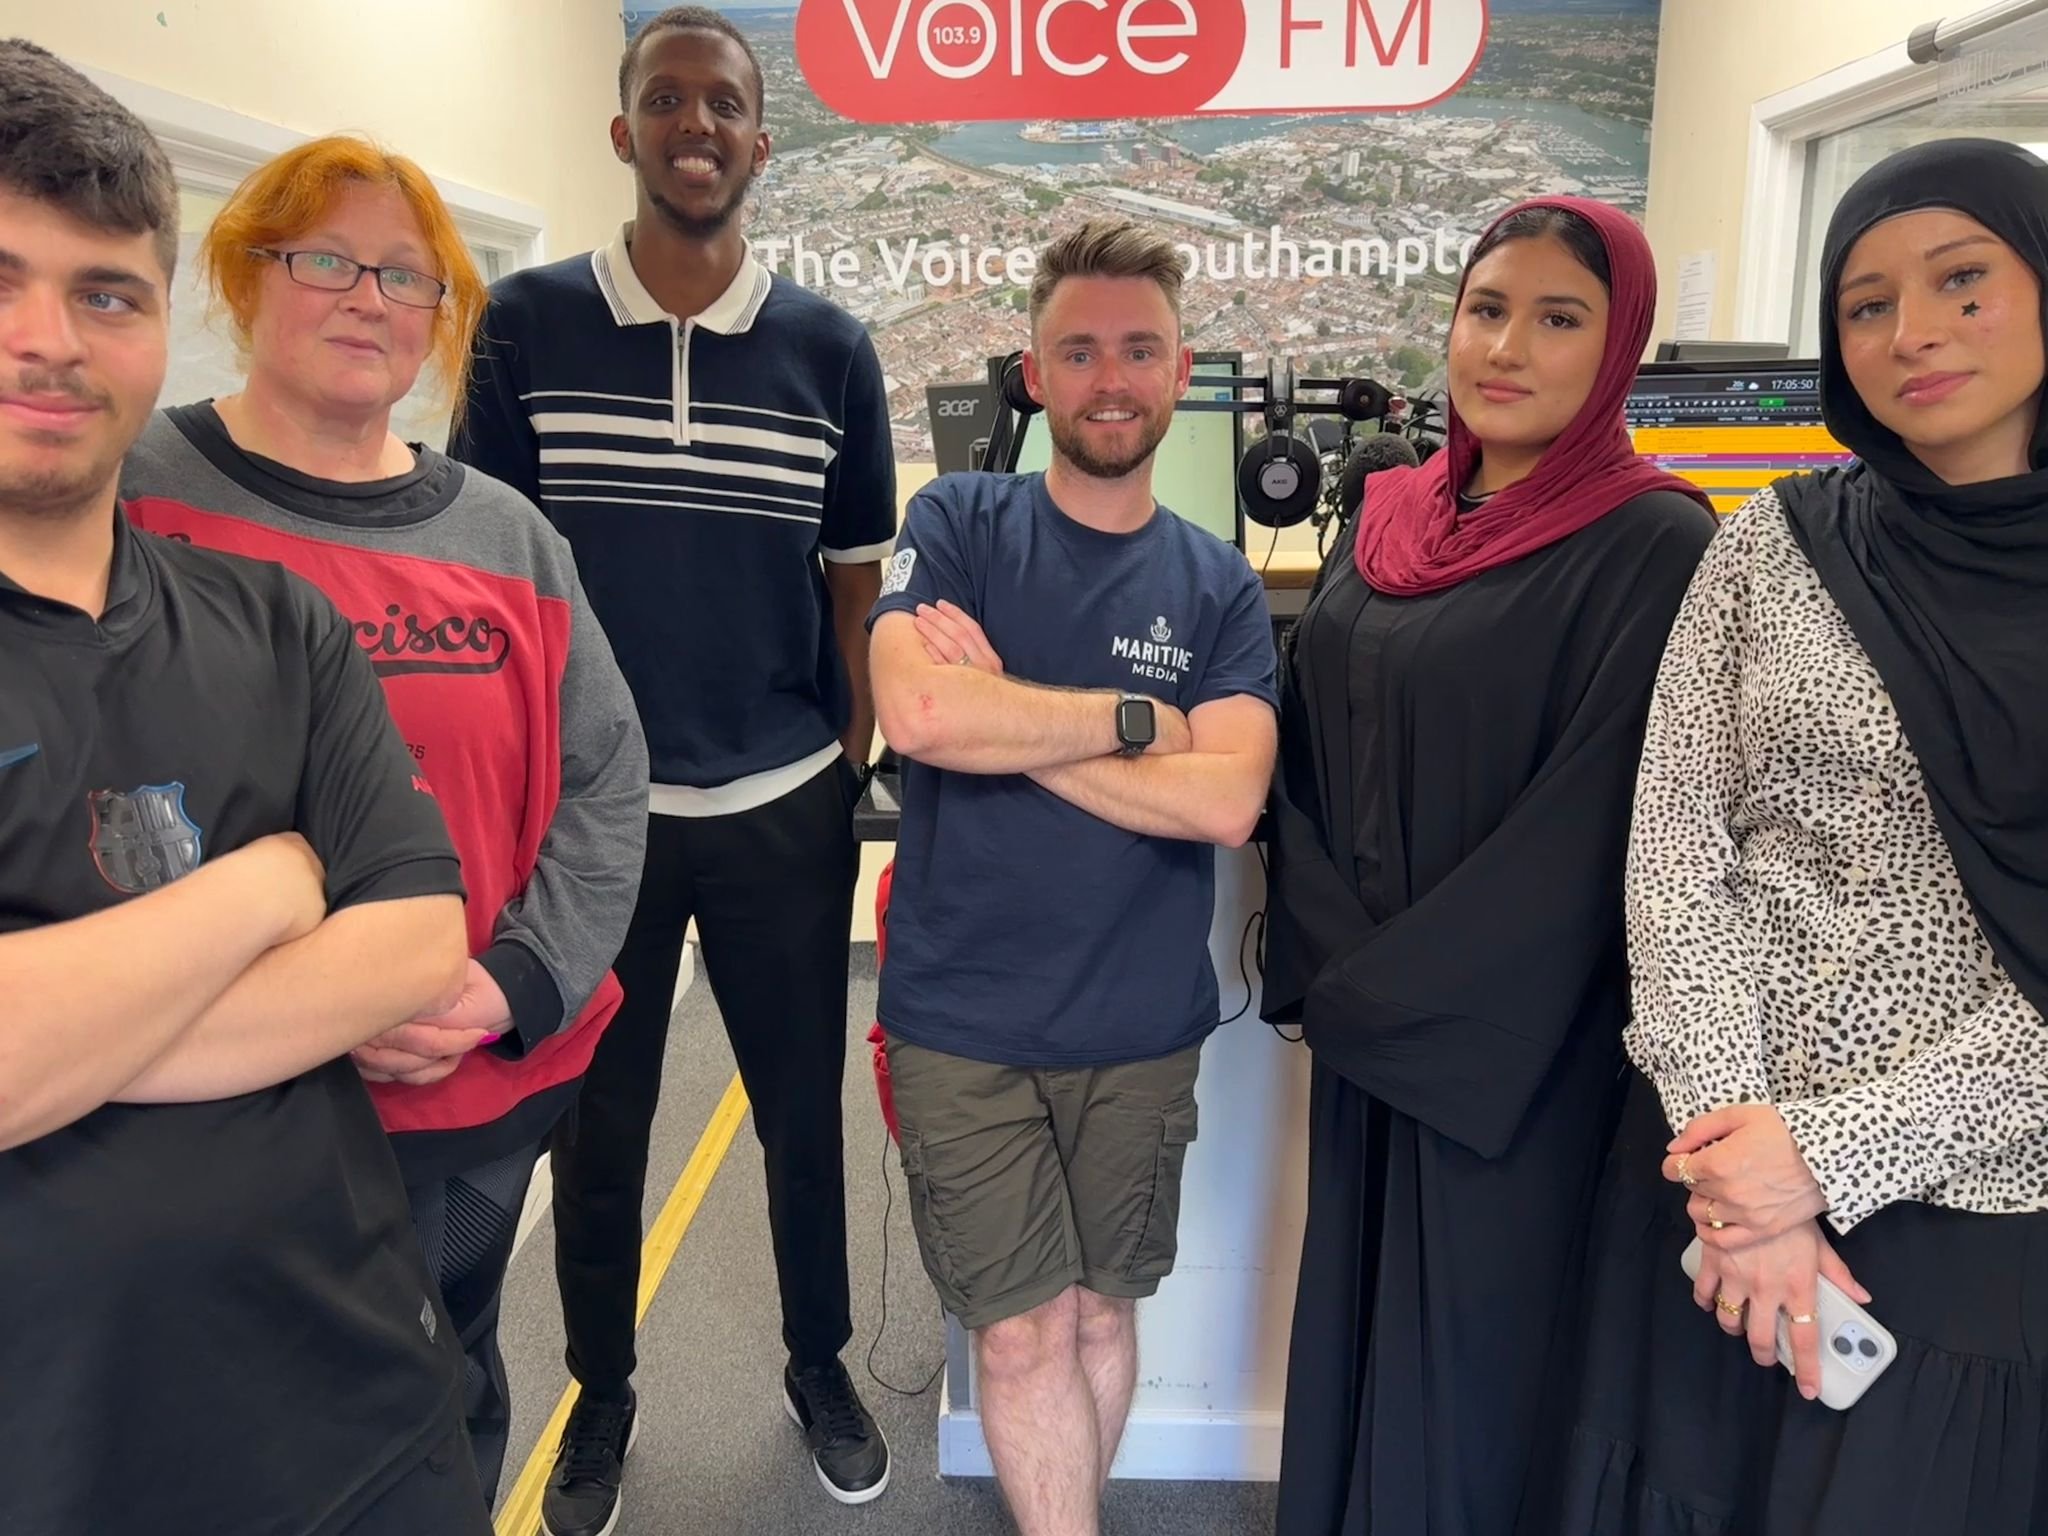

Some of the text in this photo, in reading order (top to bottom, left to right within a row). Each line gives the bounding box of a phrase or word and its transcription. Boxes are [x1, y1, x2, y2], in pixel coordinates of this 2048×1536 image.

[842, 0, 1432, 79] Voice FM
[932, 26, 982, 45] 103.9
[753, 224, 1482, 291] The Voice outhampt
[1771, 379, 1814, 390] 17:05:50
[938, 398, 979, 417] acer
[353, 604, 510, 657] cisco
[1131, 662, 1179, 684] MEDIA
